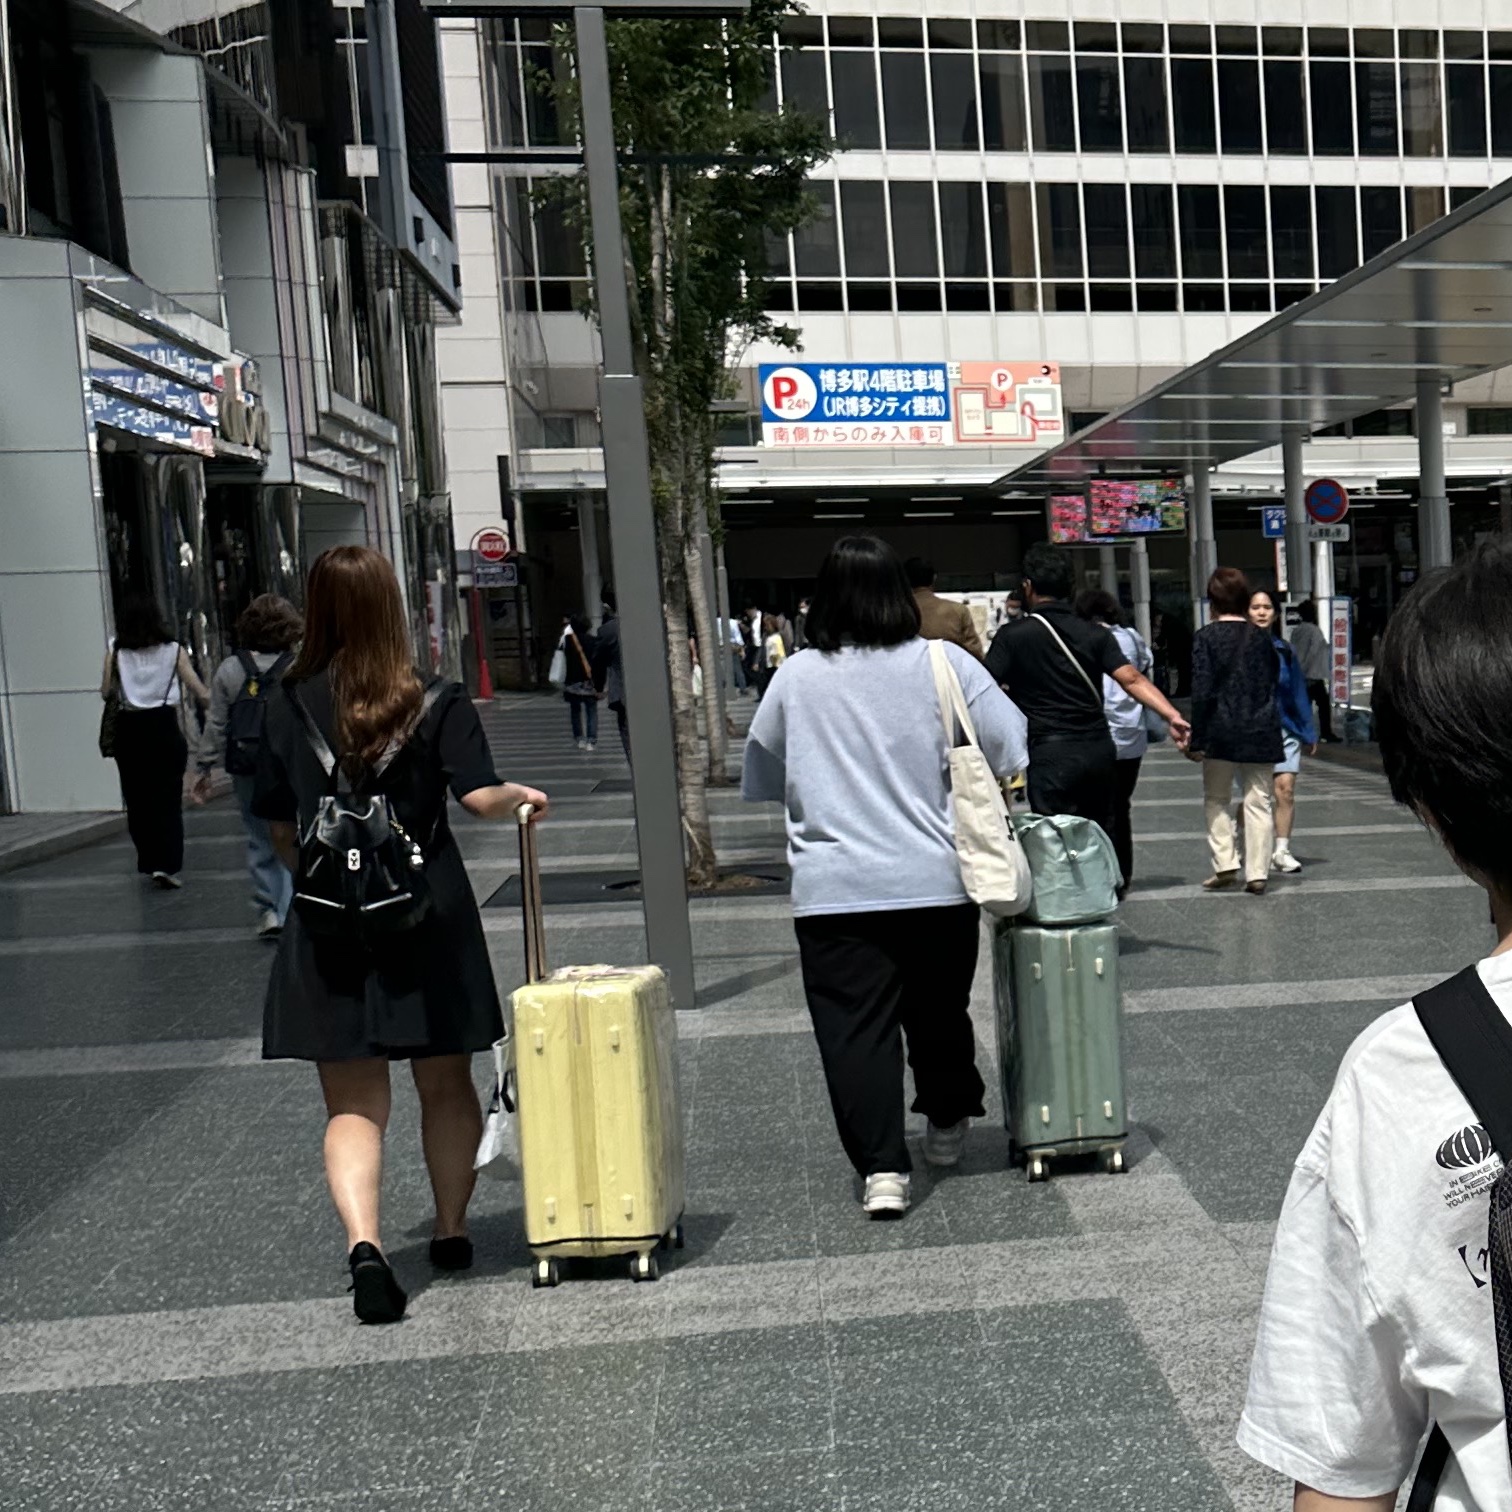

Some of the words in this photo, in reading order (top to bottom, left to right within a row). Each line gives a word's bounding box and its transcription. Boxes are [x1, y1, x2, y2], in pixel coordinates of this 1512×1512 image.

[819, 369, 945, 392] 博多駅4階駐車場
[772, 376, 798, 409] P
[787, 399, 810, 411] 24h
[773, 425, 943, 443] 南側からのみ入庫可
[1446, 1193, 1470, 1208] YOUR
